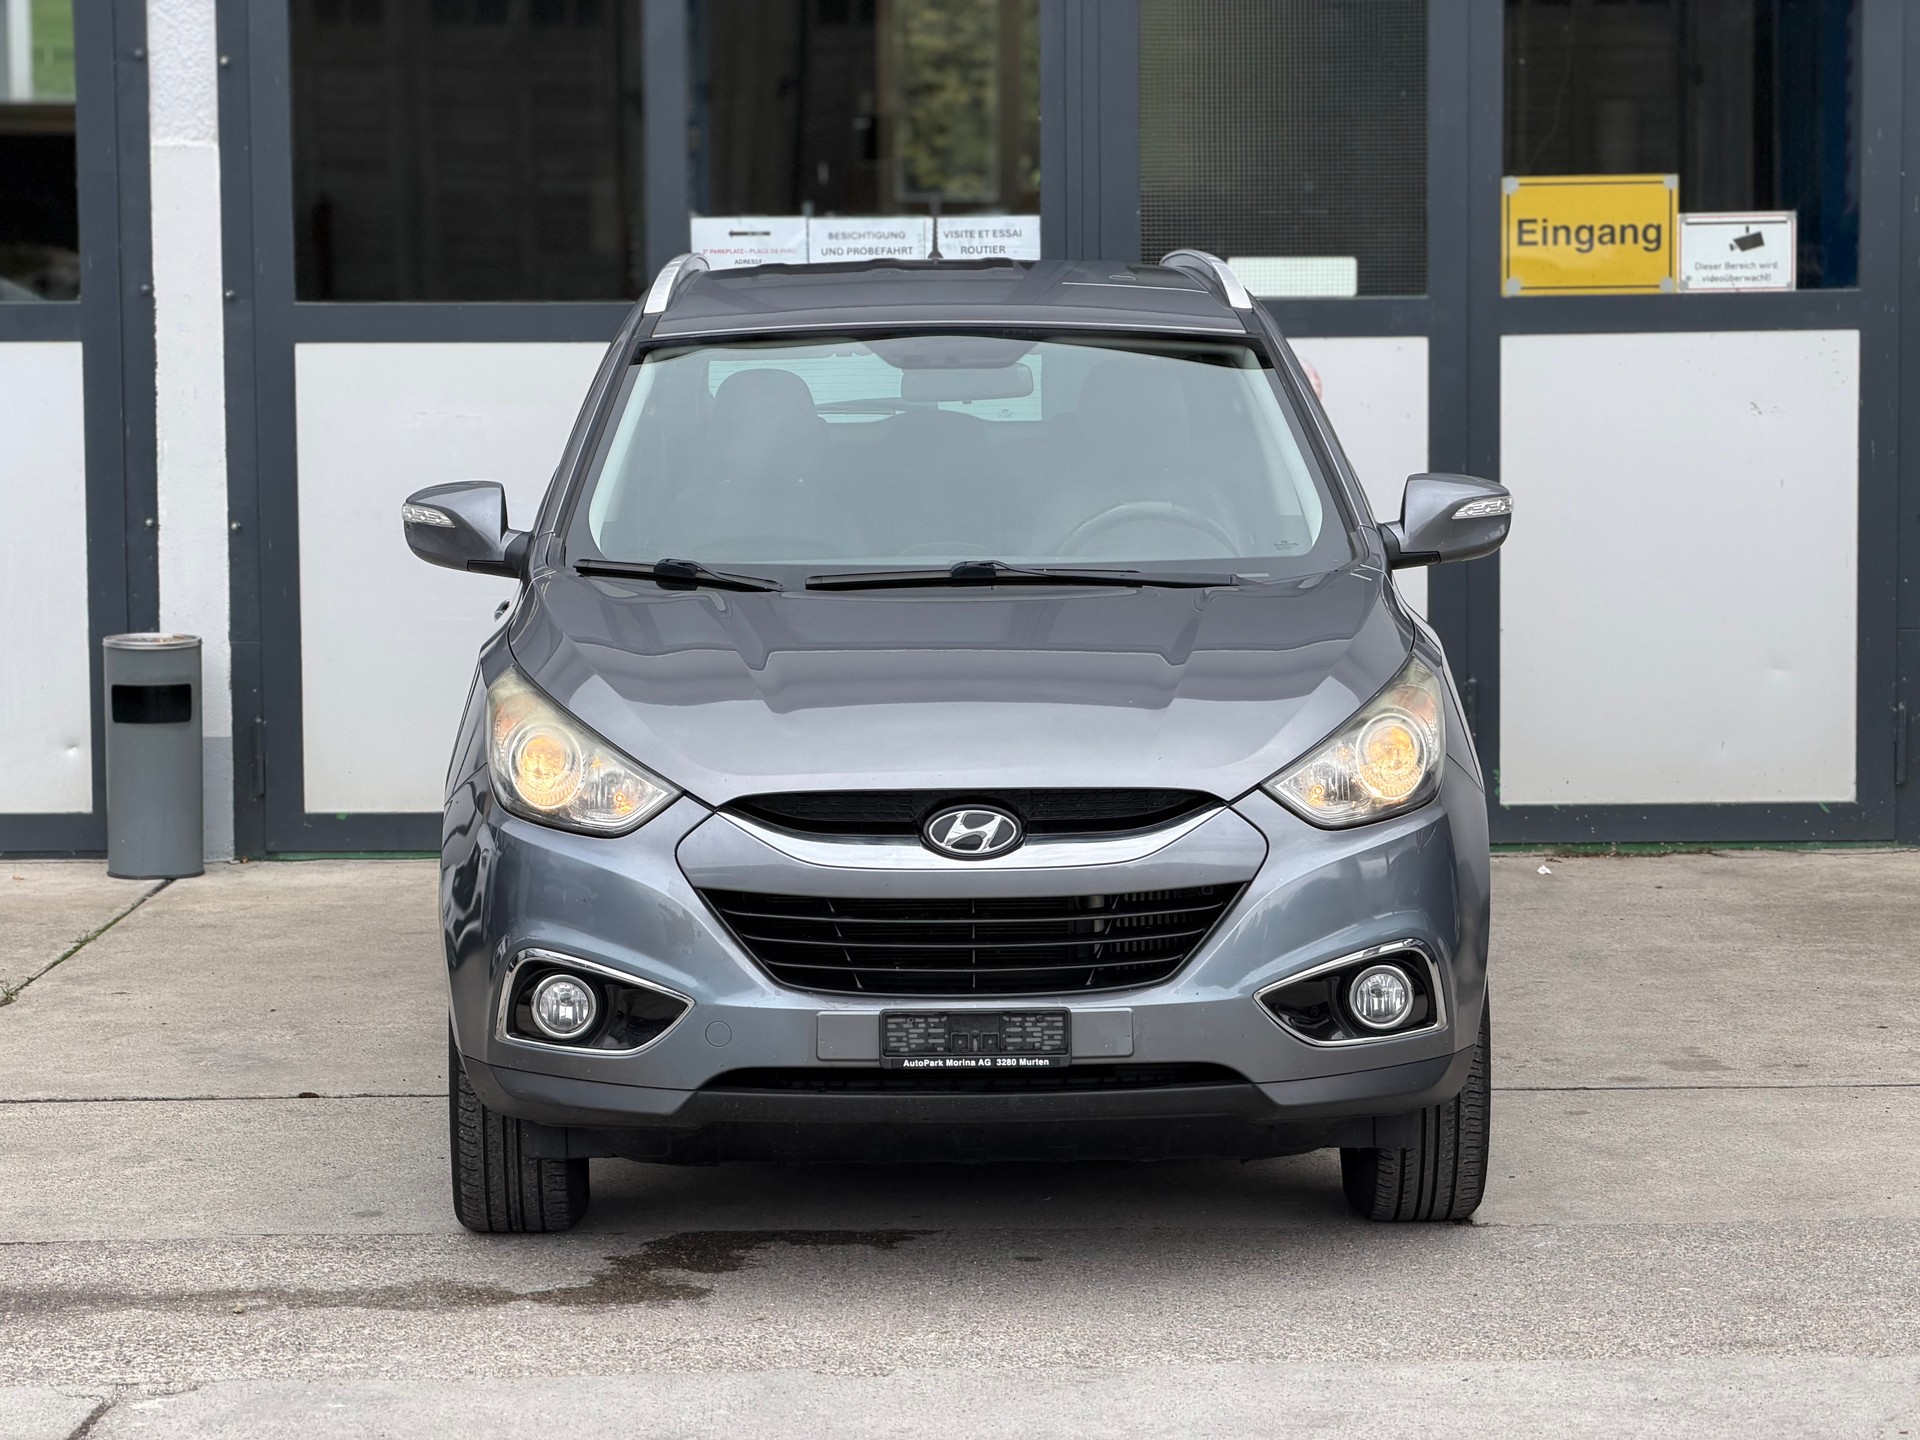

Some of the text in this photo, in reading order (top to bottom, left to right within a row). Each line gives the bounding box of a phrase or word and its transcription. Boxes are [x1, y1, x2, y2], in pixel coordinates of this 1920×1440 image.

[827, 231, 907, 241] BESICHTIGUNG
[942, 229, 1023, 239] VISITE ET ESSAI
[1517, 218, 1663, 253] Eingang
[821, 246, 913, 256] UND PROBEFAHRT
[960, 245, 1006, 255] ROUTIER
[1694, 261, 1779, 271] Dieser Bereich wird
[1702, 272, 1772, 283] videoüberwacht!
[903, 1058, 1050, 1067] AutoPark Morina AG 3280 Murten
